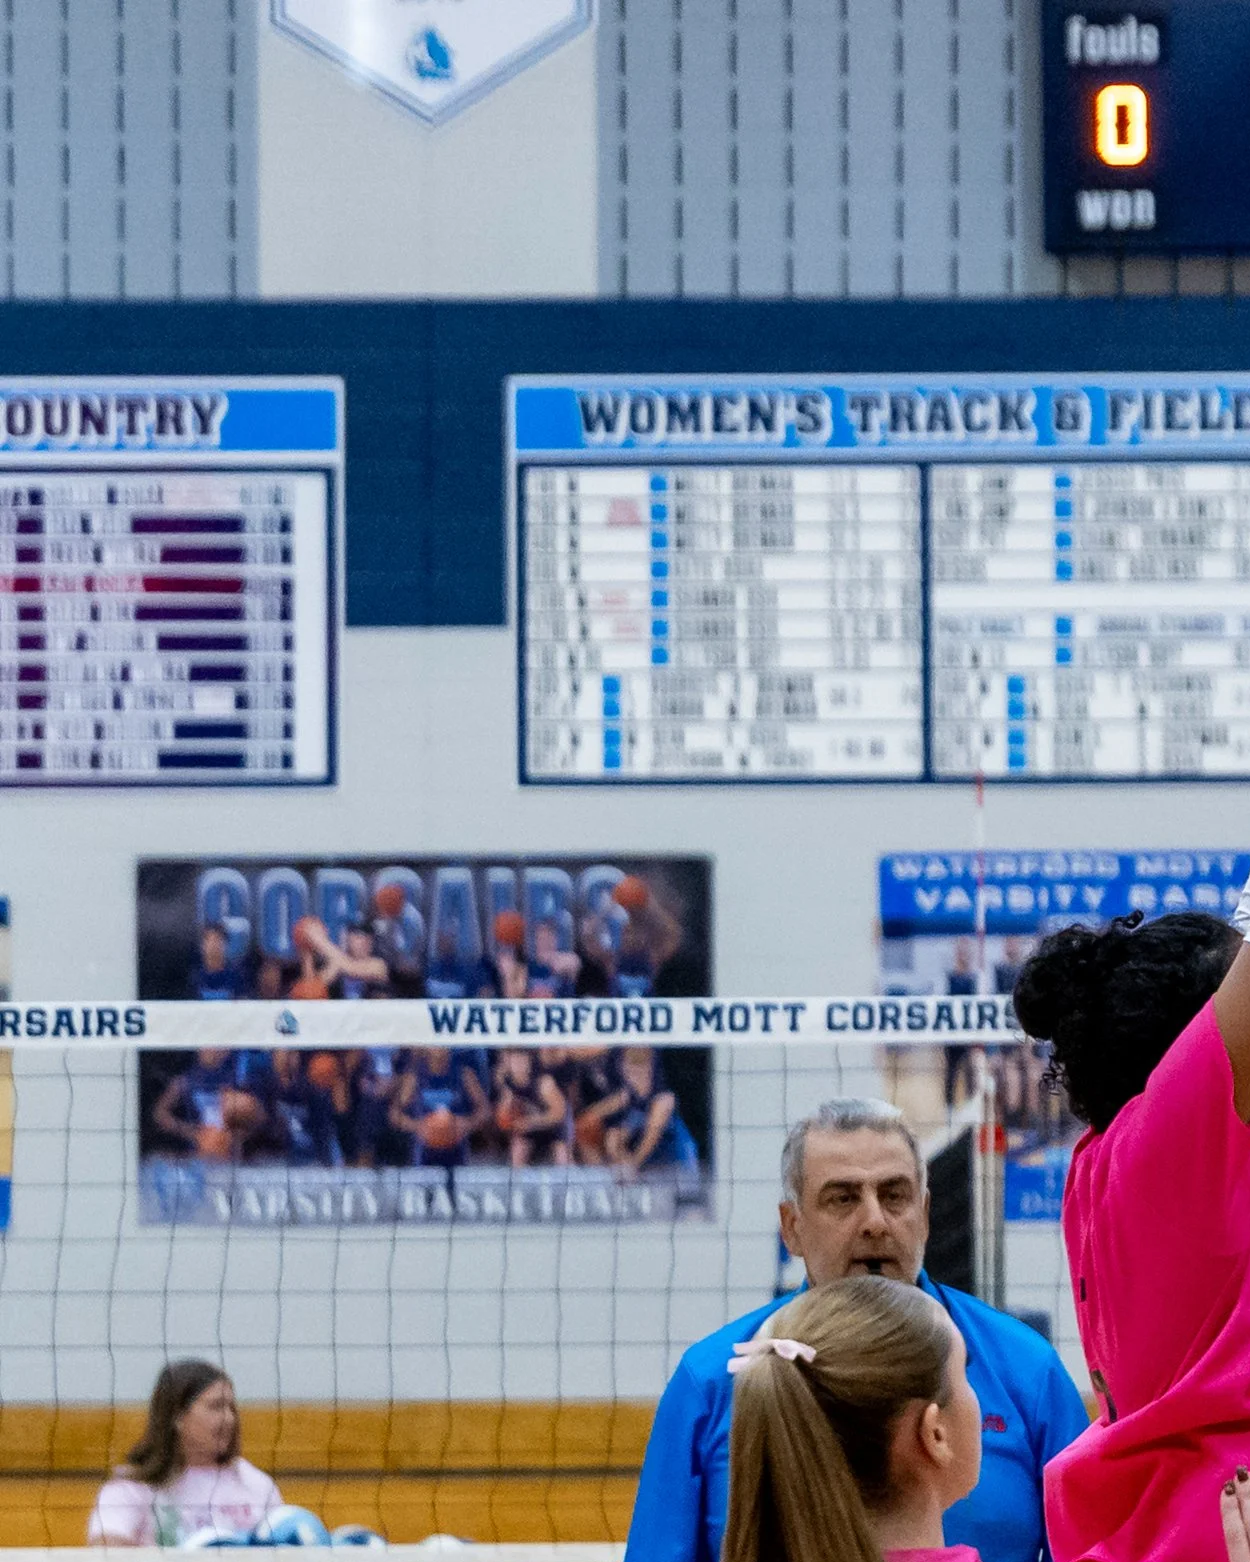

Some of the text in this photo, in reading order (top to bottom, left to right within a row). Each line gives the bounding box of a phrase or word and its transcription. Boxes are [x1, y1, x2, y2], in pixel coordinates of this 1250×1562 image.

[1066, 15, 1161, 65] fouls
[1097, 84, 1149, 167] 0
[1078, 189, 1156, 230] won
[4, 395, 223, 437] OUNTRY
[580, 394, 824, 434] WOMEN'S
[850, 393, 1034, 432] TRACK
[429, 1002, 674, 1035] WATERFORD
[692, 1002, 808, 1034] MOTT
